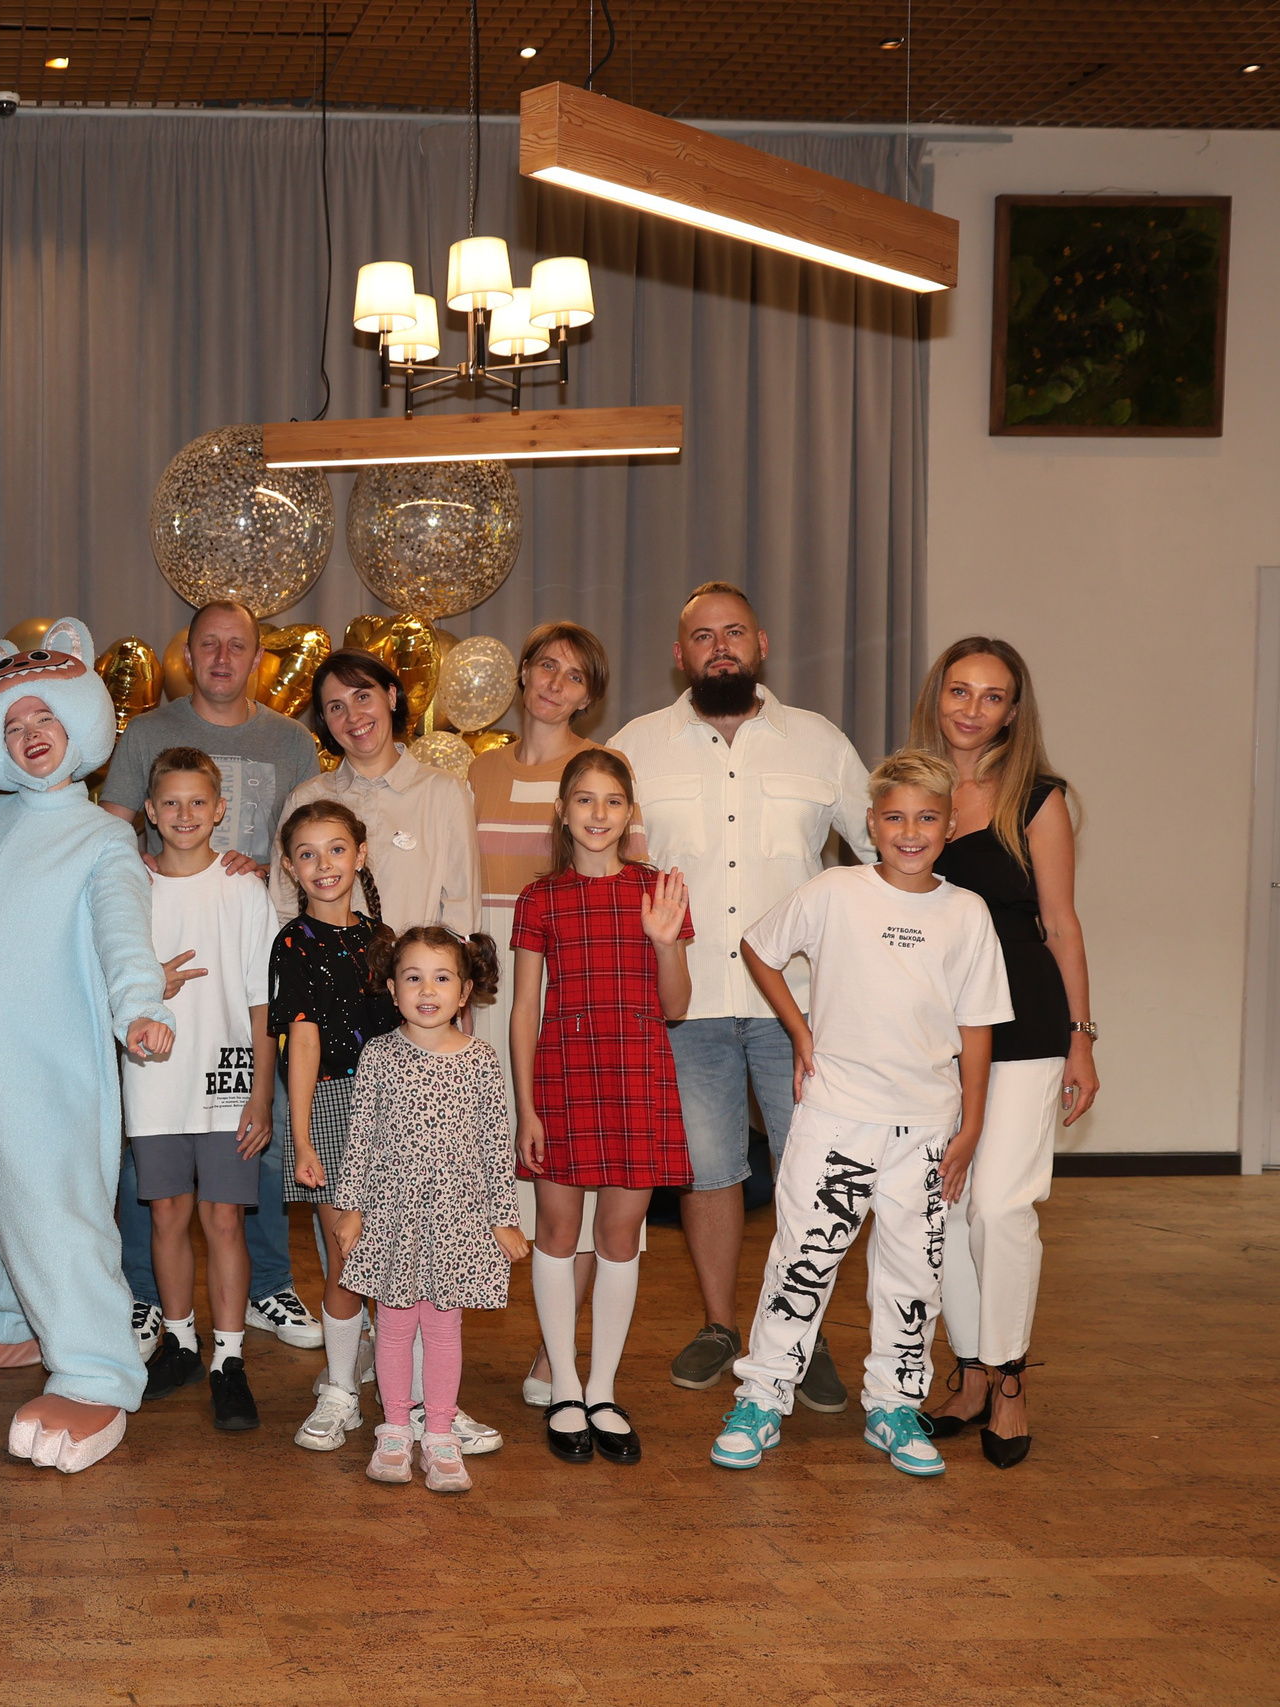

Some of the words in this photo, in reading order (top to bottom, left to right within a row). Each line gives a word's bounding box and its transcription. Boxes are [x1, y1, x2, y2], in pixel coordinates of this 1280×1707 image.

[242, 758, 259, 858] ENJOY
[887, 926, 922, 934] ФУТБОЛКА
[899, 934, 926, 942] ВЫХОДА
[770, 1149, 877, 1322] URBAN
